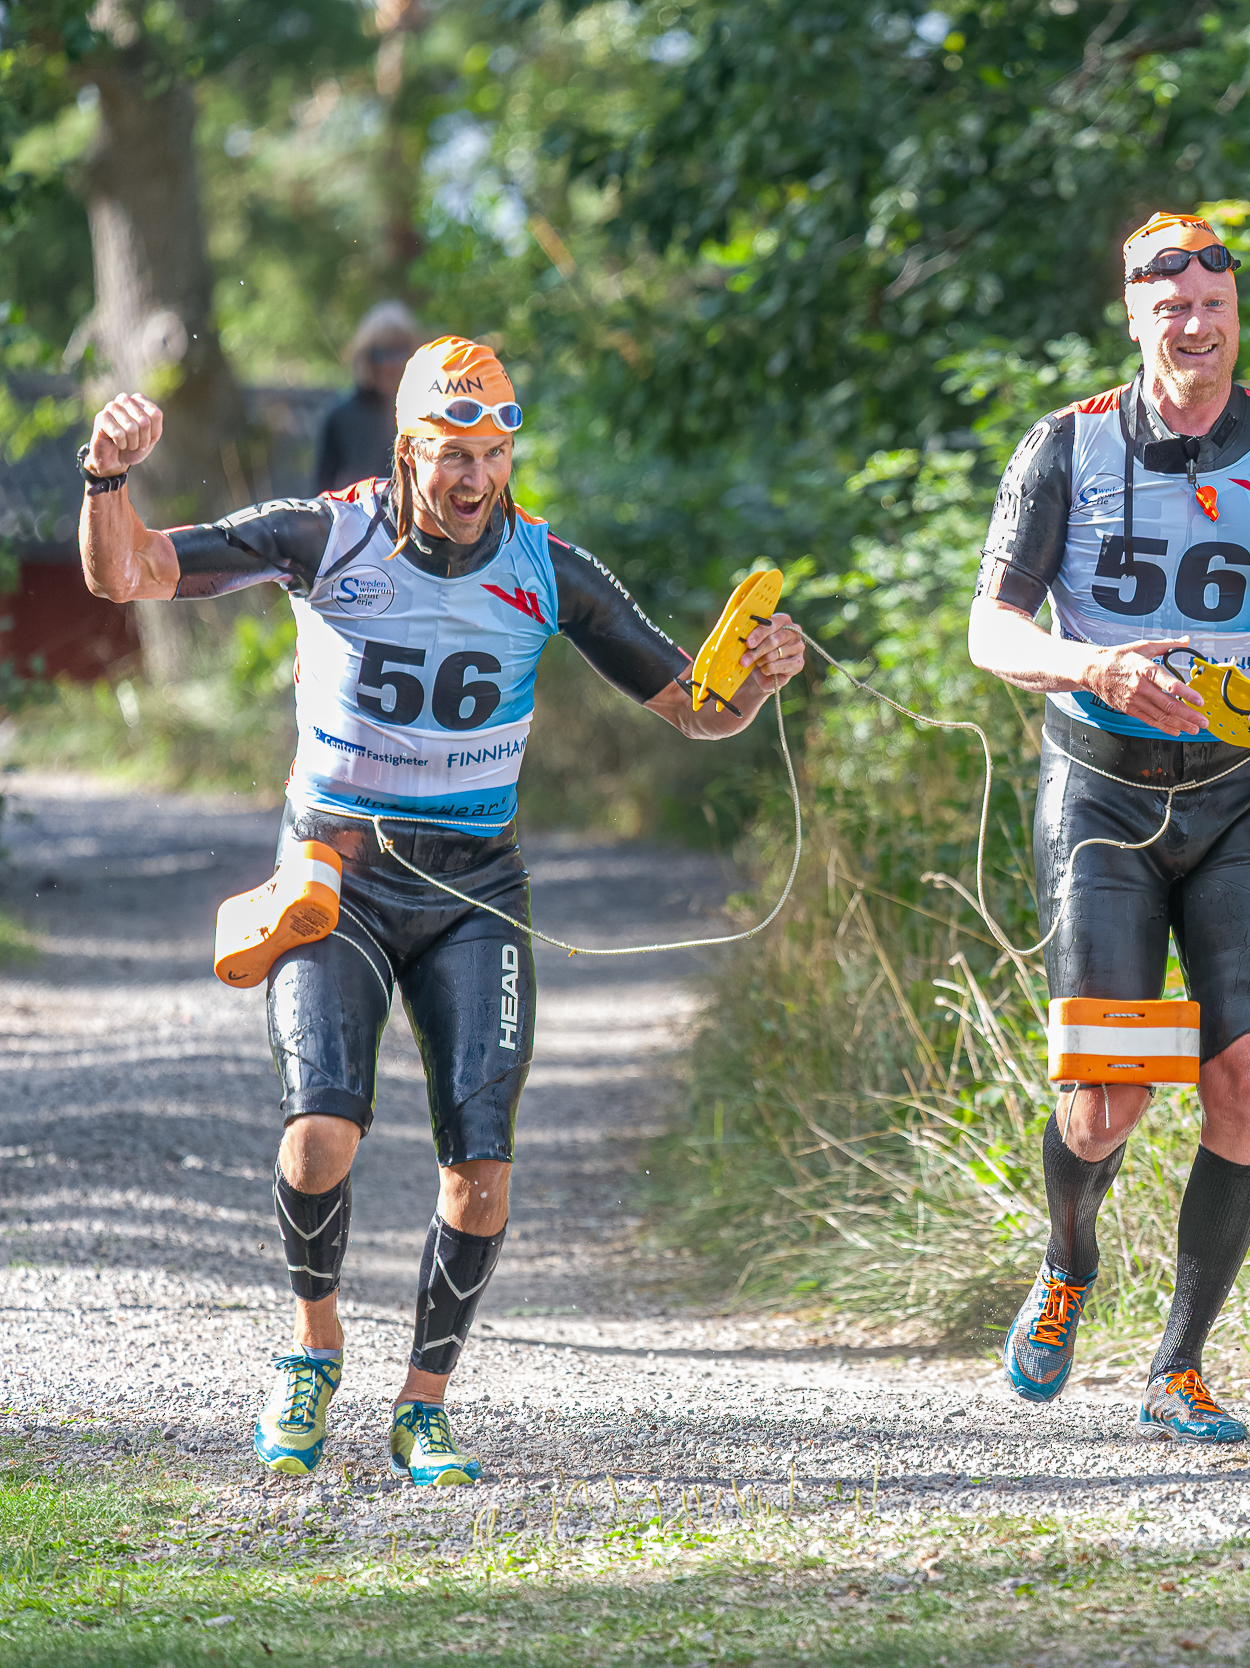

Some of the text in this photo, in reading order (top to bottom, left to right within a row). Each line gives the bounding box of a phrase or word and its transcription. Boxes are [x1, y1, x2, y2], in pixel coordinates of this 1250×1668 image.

[574, 547, 674, 645] SWIM RUN
[356, 640, 502, 731] 56
[366, 750, 429, 766] Fastigheter
[499, 944, 519, 1051] HEAD
